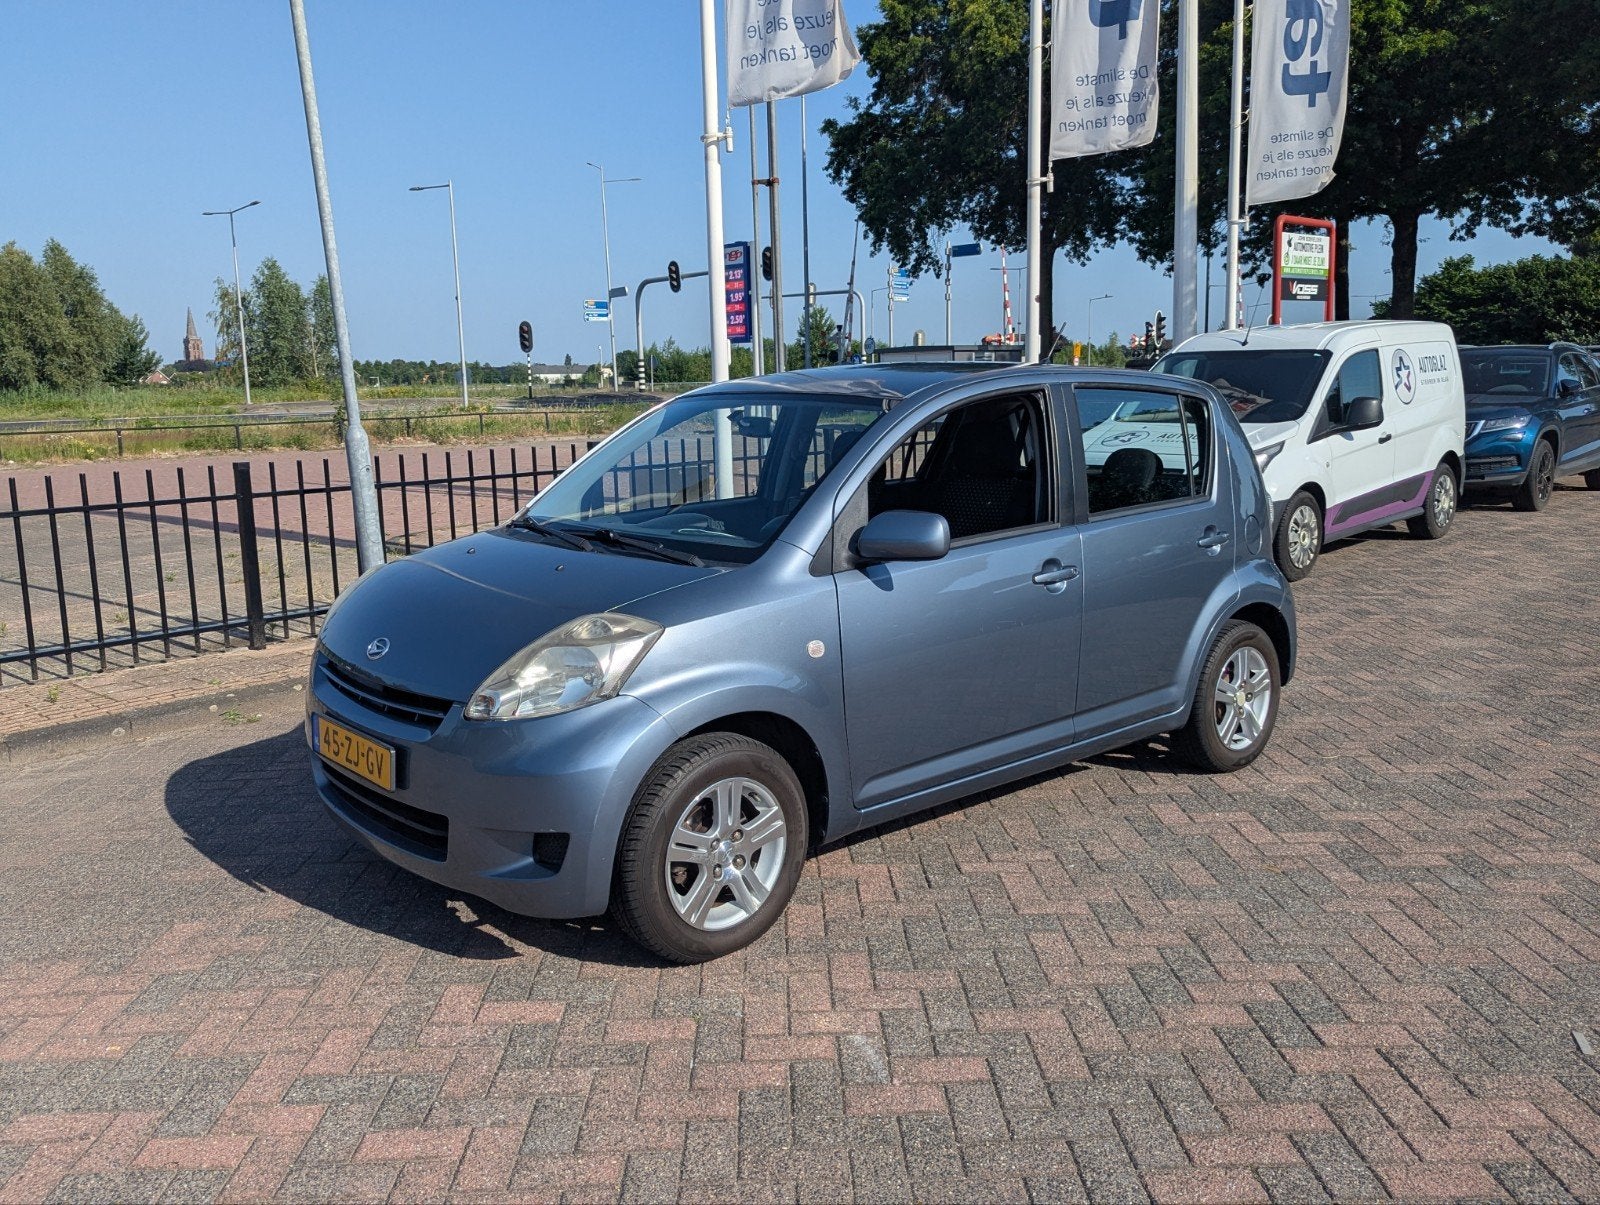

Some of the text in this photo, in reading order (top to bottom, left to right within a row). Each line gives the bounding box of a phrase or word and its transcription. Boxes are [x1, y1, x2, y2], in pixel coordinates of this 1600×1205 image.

[1289, 281, 1319, 295] VOSS
[1418, 354, 1447, 373] AUTOGLAZ
[323, 726, 384, 780] 45-ZJ-GV
